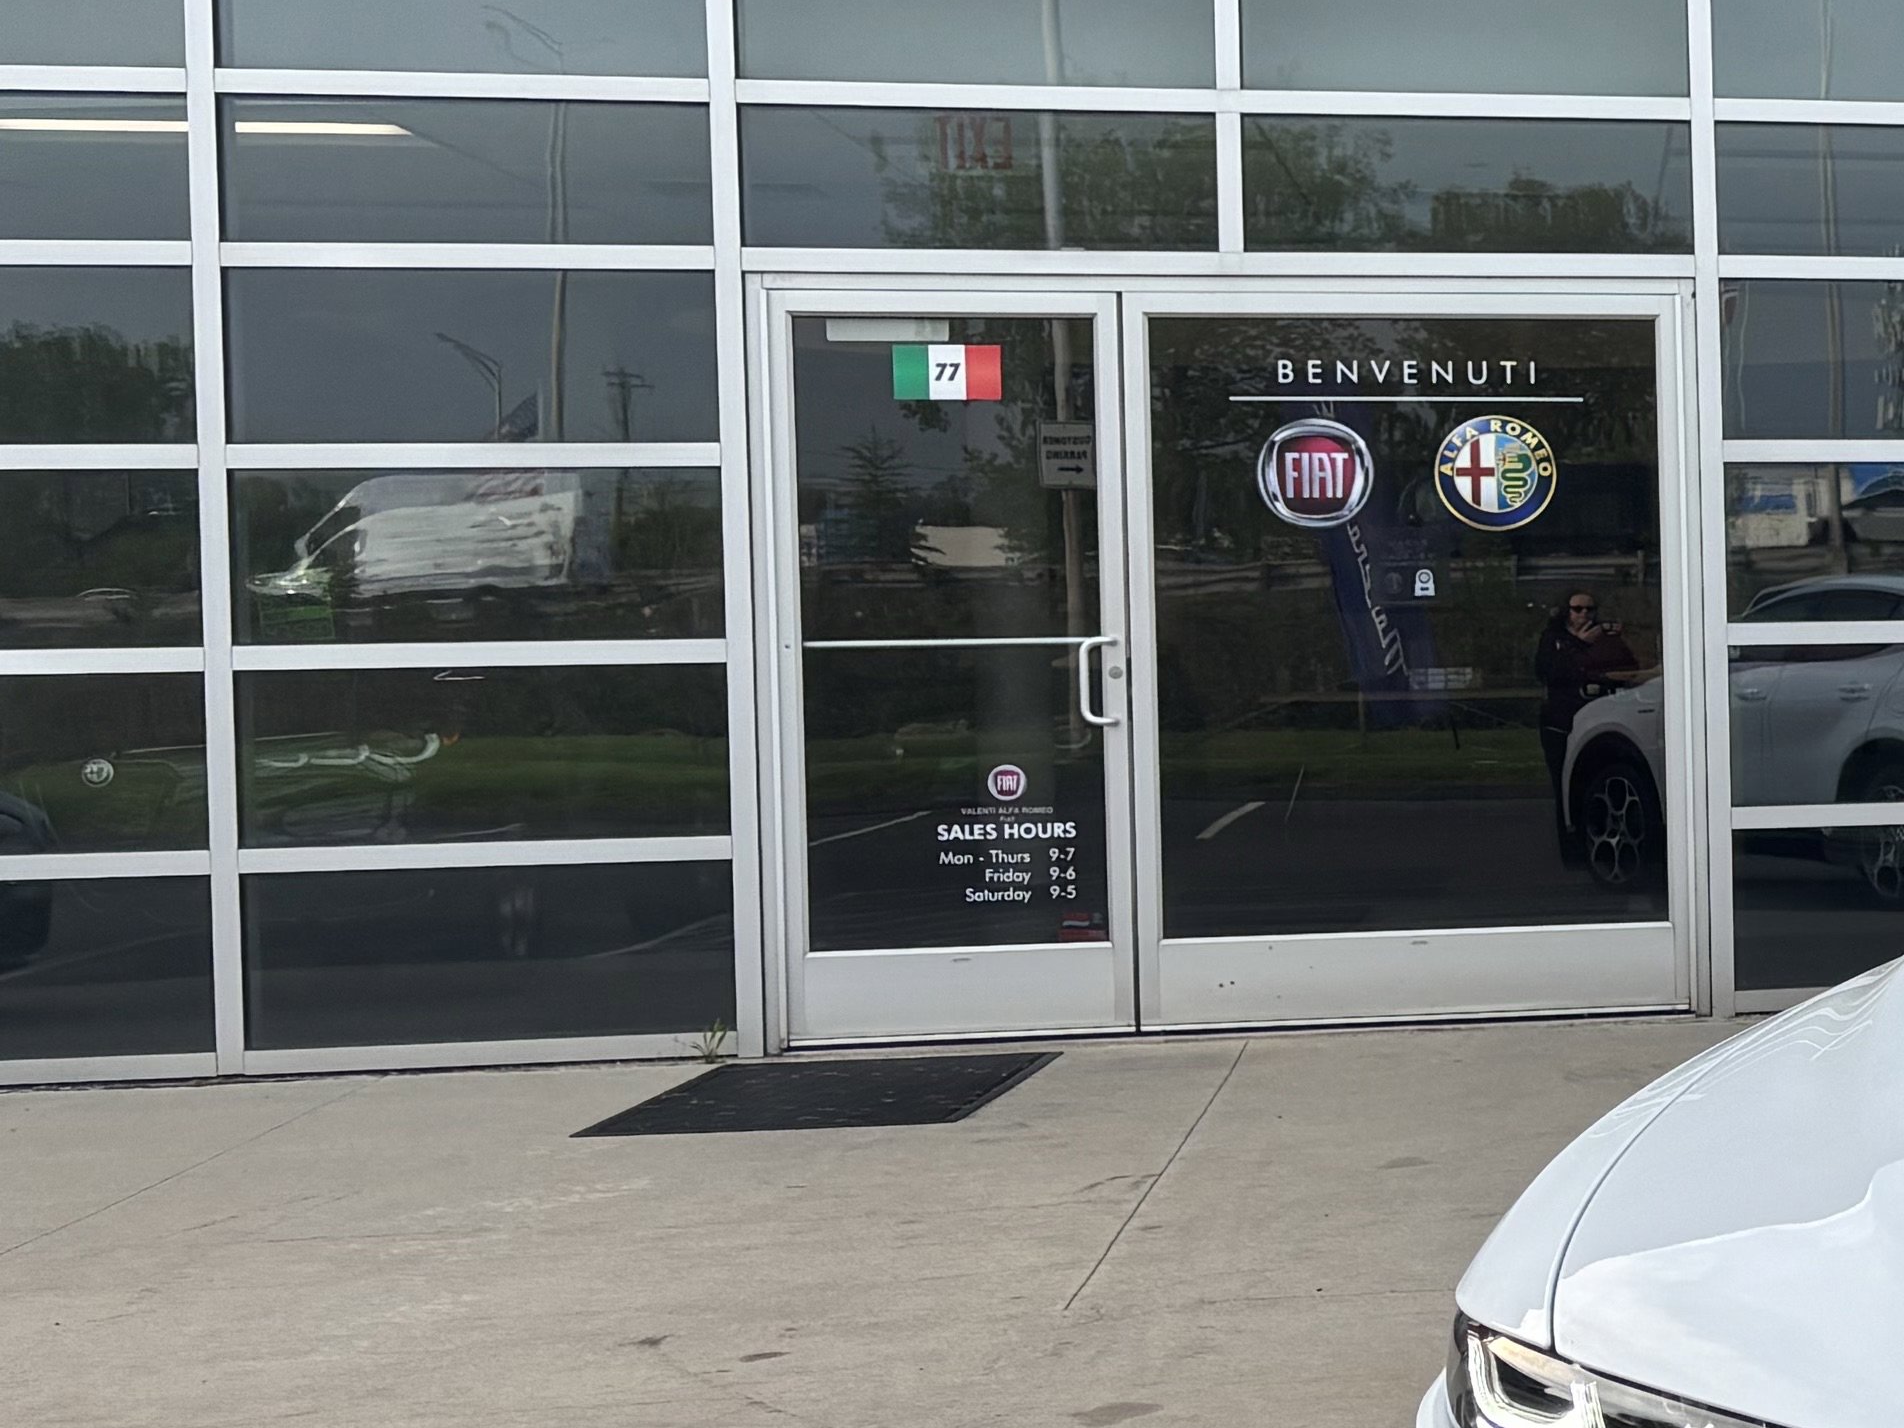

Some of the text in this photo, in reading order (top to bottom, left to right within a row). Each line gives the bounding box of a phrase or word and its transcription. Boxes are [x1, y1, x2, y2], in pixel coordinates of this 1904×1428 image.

[934, 362, 962, 382] 77
[1277, 359, 1536, 385] BENVENUTI
[1439, 419, 1552, 477] ALFA ROMEO
[1284, 451, 1350, 499] FIAT
[996, 775, 1018, 791] FIAT
[960, 806, 1054, 815] VALENTI ALFA ROMEO
[936, 821, 1077, 841] SALES HOURS
[938, 851, 974, 865] Mon
[989, 849, 1031, 864] Thurs
[1049, 847, 1076, 861] 9-7
[984, 866, 1076, 884] Friday 9-6
[965, 885, 1077, 903] Saturday 9-5
